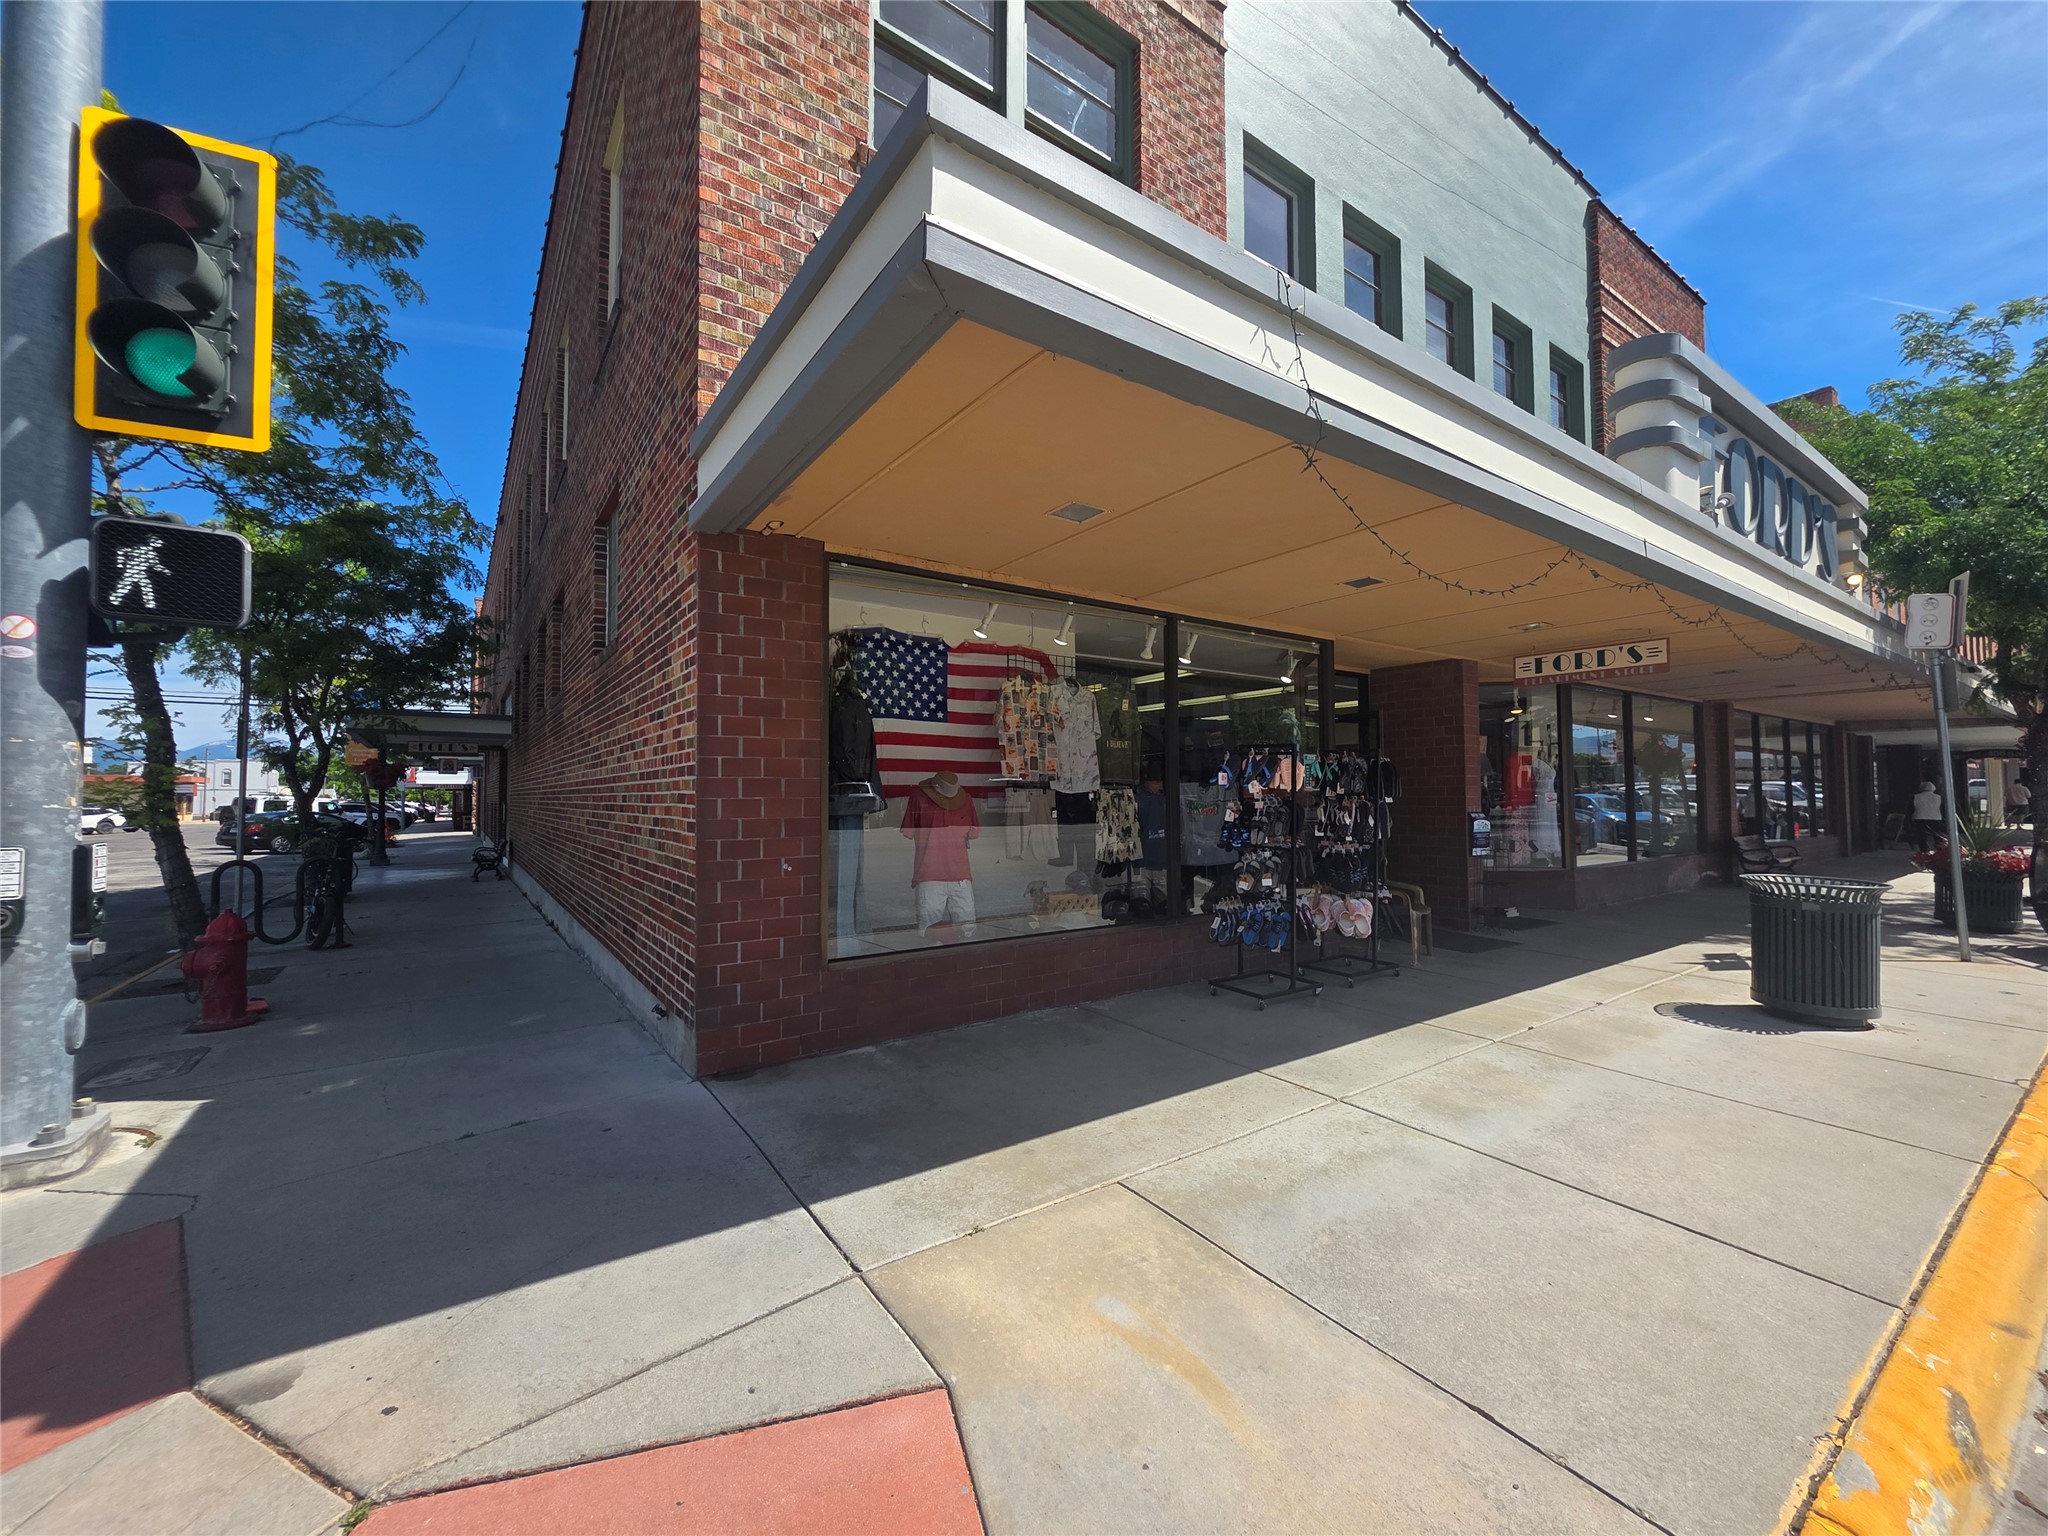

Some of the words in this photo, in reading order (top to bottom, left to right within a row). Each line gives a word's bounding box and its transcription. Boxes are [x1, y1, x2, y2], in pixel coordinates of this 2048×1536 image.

[1699, 415, 1839, 583] FORD'S
[1535, 645, 1643, 674] FORD'S
[1615, 665, 1655, 677] STORE
